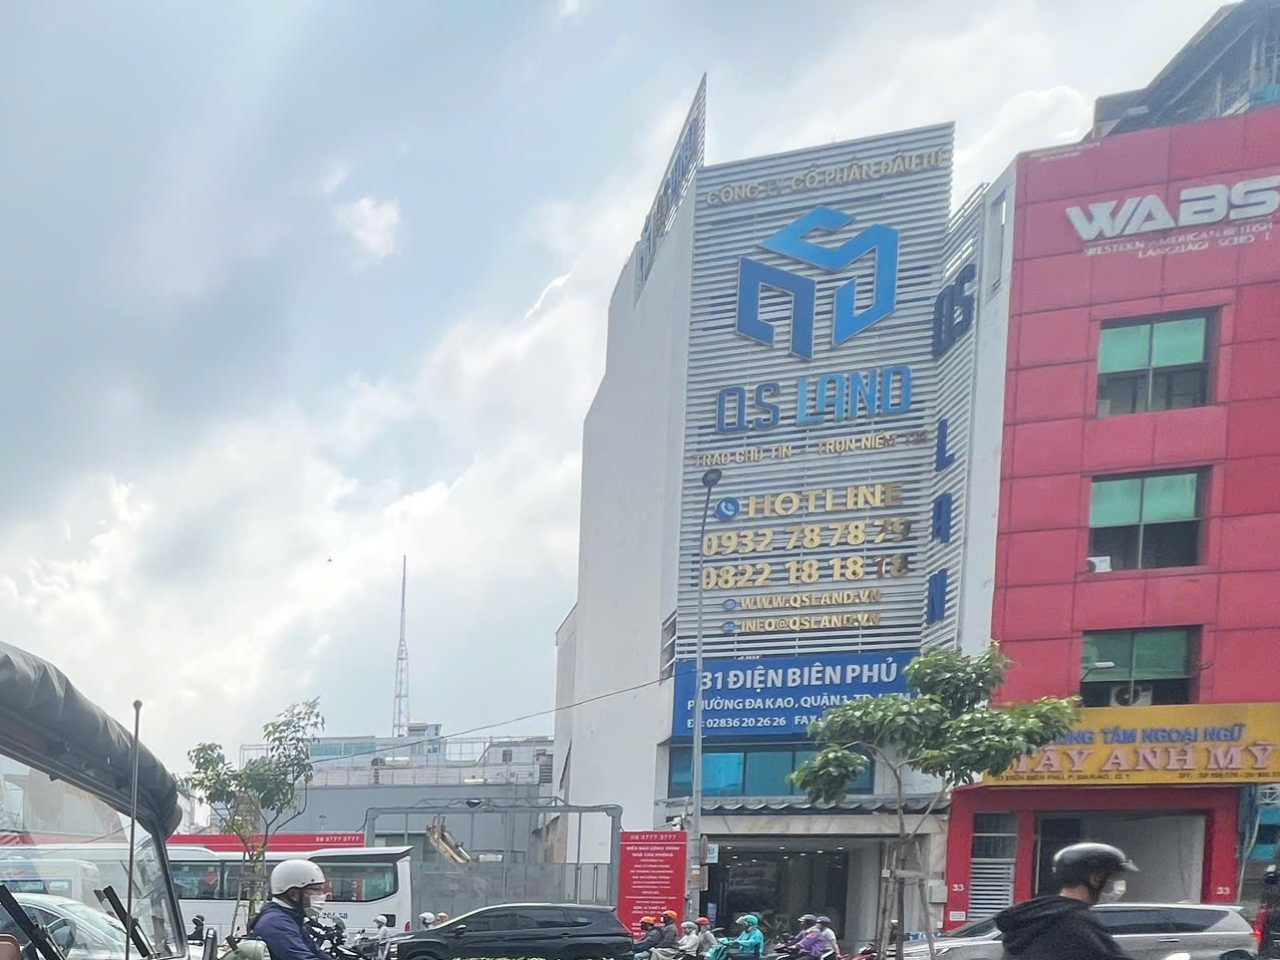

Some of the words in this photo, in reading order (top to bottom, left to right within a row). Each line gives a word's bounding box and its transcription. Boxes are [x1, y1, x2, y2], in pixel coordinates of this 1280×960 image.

[1065, 175, 1280, 241] WABS
[796, 364, 912, 426] LAND
[748, 482, 903, 518] HOTLINE
[702, 528, 774, 556] 0932
[784, 523, 820, 550] 78
[827, 520, 866, 547] 78
[701, 561, 772, 590] 0822
[784, 559, 820, 584] 18
[829, 556, 865, 581] 18
[727, 665, 783, 693] ĐIỆN
[786, 662, 842, 688] BIÊN
[846, 656, 898, 684] PHỦ
[706, 717, 740, 728] 02836
[741, 717, 755, 727] 20
[756, 716, 771, 727] 26
[772, 716, 787, 727] 26
[1102, 745, 1197, 772] ANH
[1206, 741, 1276, 770] MỸ
